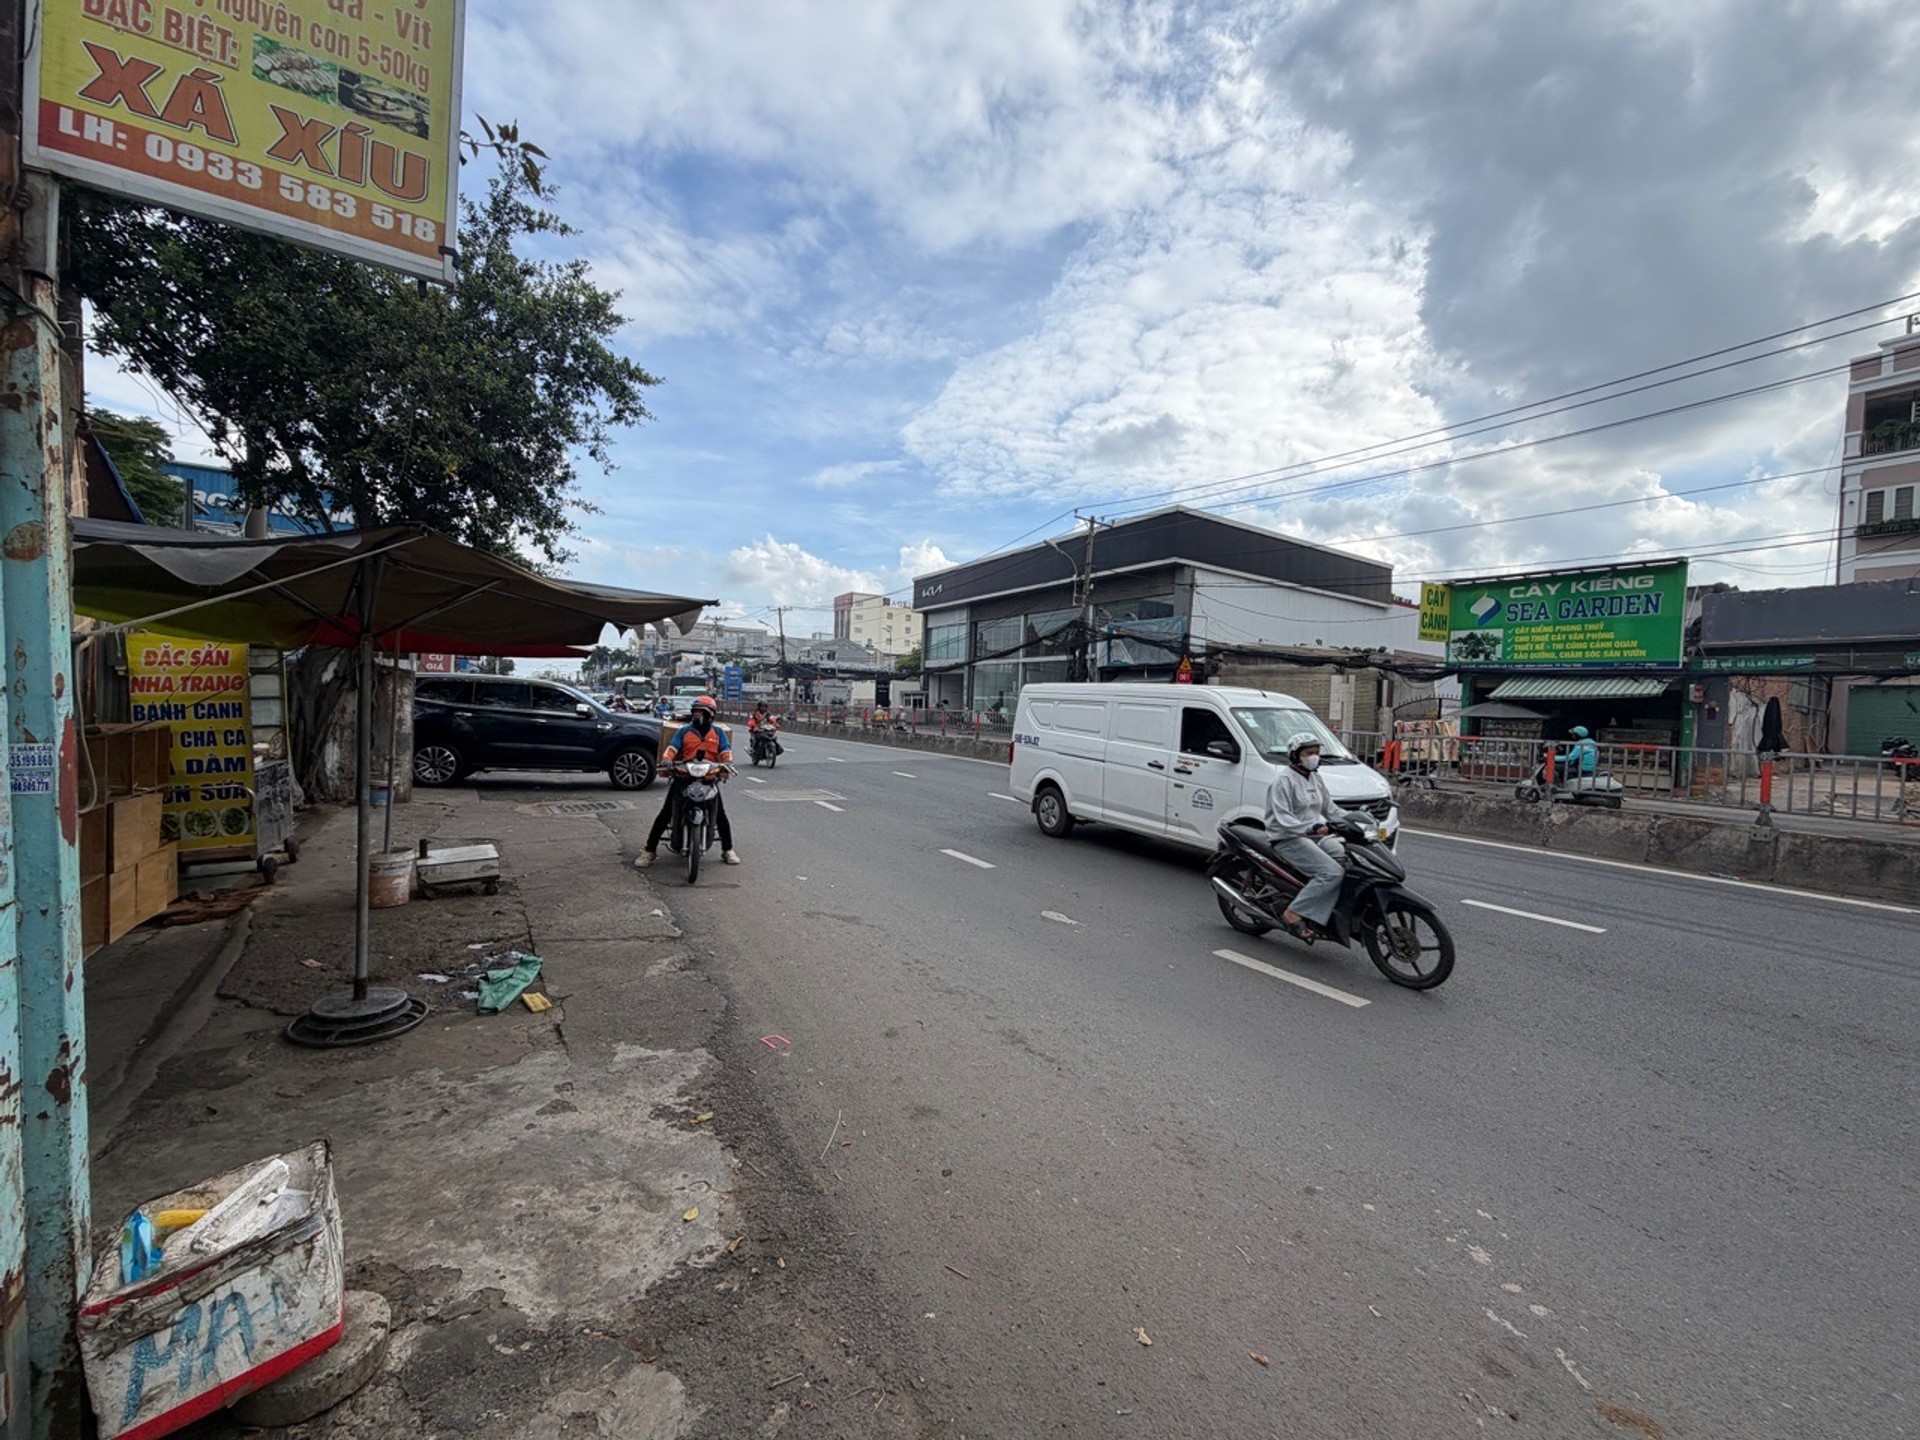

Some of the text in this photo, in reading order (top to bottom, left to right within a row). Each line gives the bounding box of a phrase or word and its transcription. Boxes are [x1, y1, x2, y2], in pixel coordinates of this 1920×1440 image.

[163, 7, 240, 66] BIỆT:
[394, 7, 432, 51] Vịt
[309, 22, 350, 60] con
[357, 35, 430, 94] 5-50kg
[77, 39, 429, 203] XÁ XÍU
[57, 107, 437, 243] LH: 0933 583 518
[1506, 592, 1663, 623] SEA GARDEN
[143, 643, 231, 672] ĐẶC SẢN
[131, 674, 245, 693] NHA TRANG
[133, 701, 243, 722] BÁNH CANH
[180, 726, 218, 748] CHẢ
[223, 726, 246, 746] CÁ
